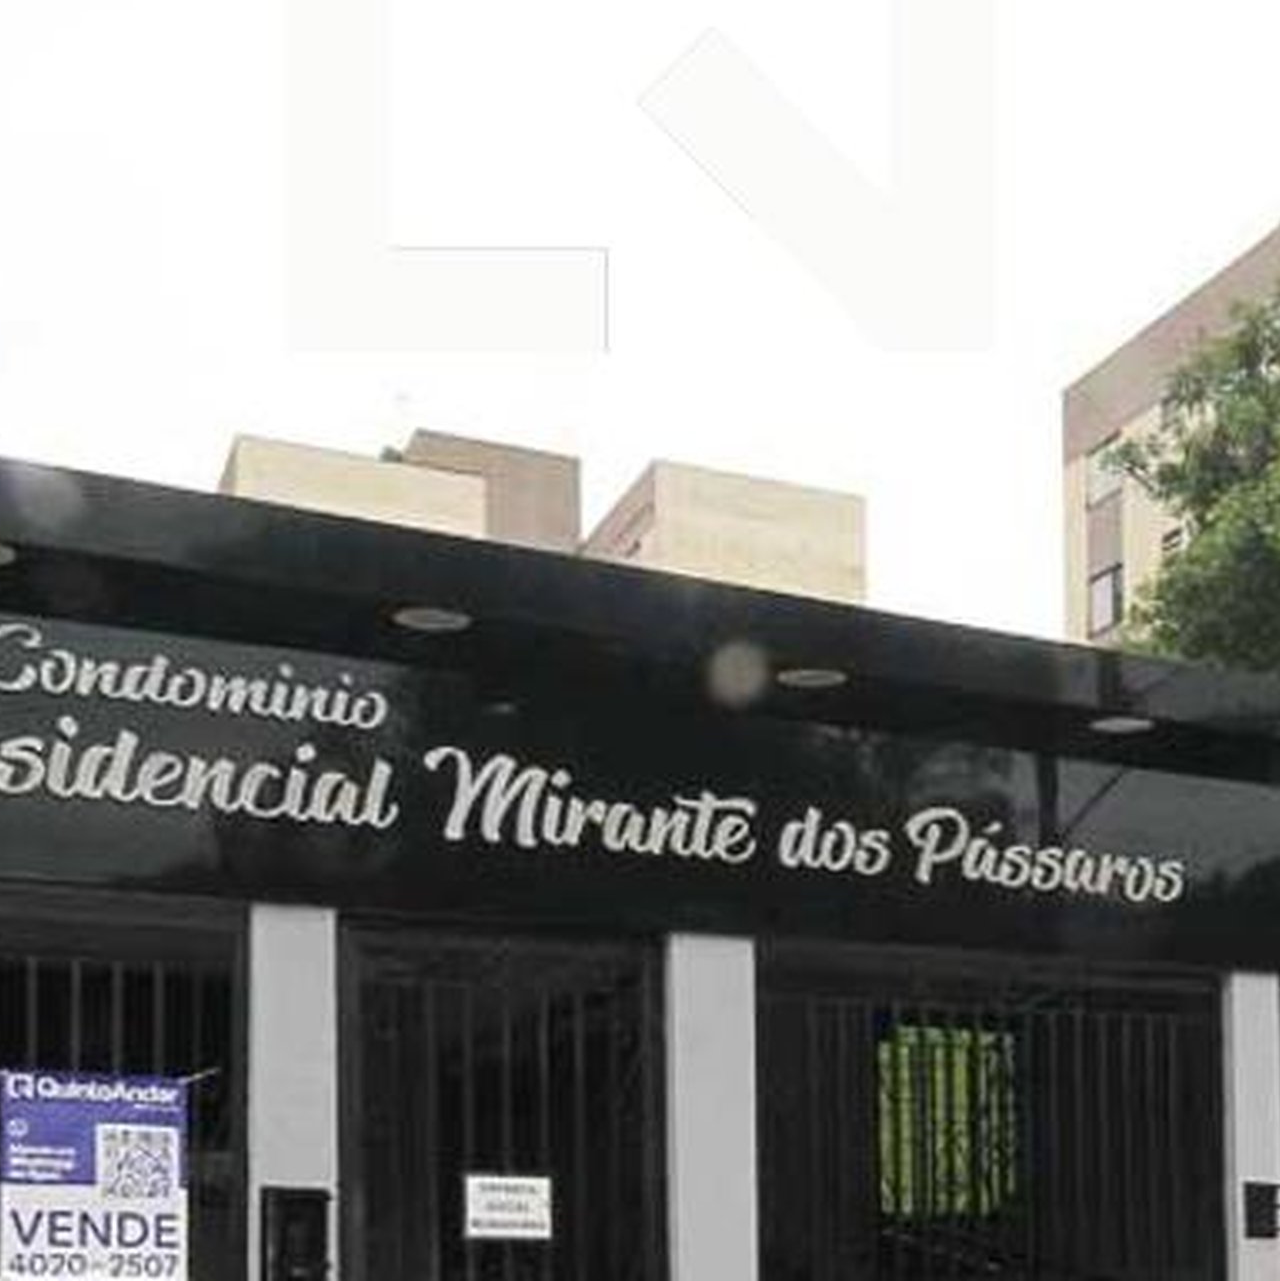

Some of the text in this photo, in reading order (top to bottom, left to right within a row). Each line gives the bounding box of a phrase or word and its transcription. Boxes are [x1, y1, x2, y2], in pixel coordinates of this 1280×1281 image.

[423, 746, 755, 864] Mirante
[778, 808, 892, 874] dos
[904, 806, 1183, 903] Pássaros
[37, 1076, 178, 1103] QuintoAndar
[10, 1209, 180, 1248] VENDE
